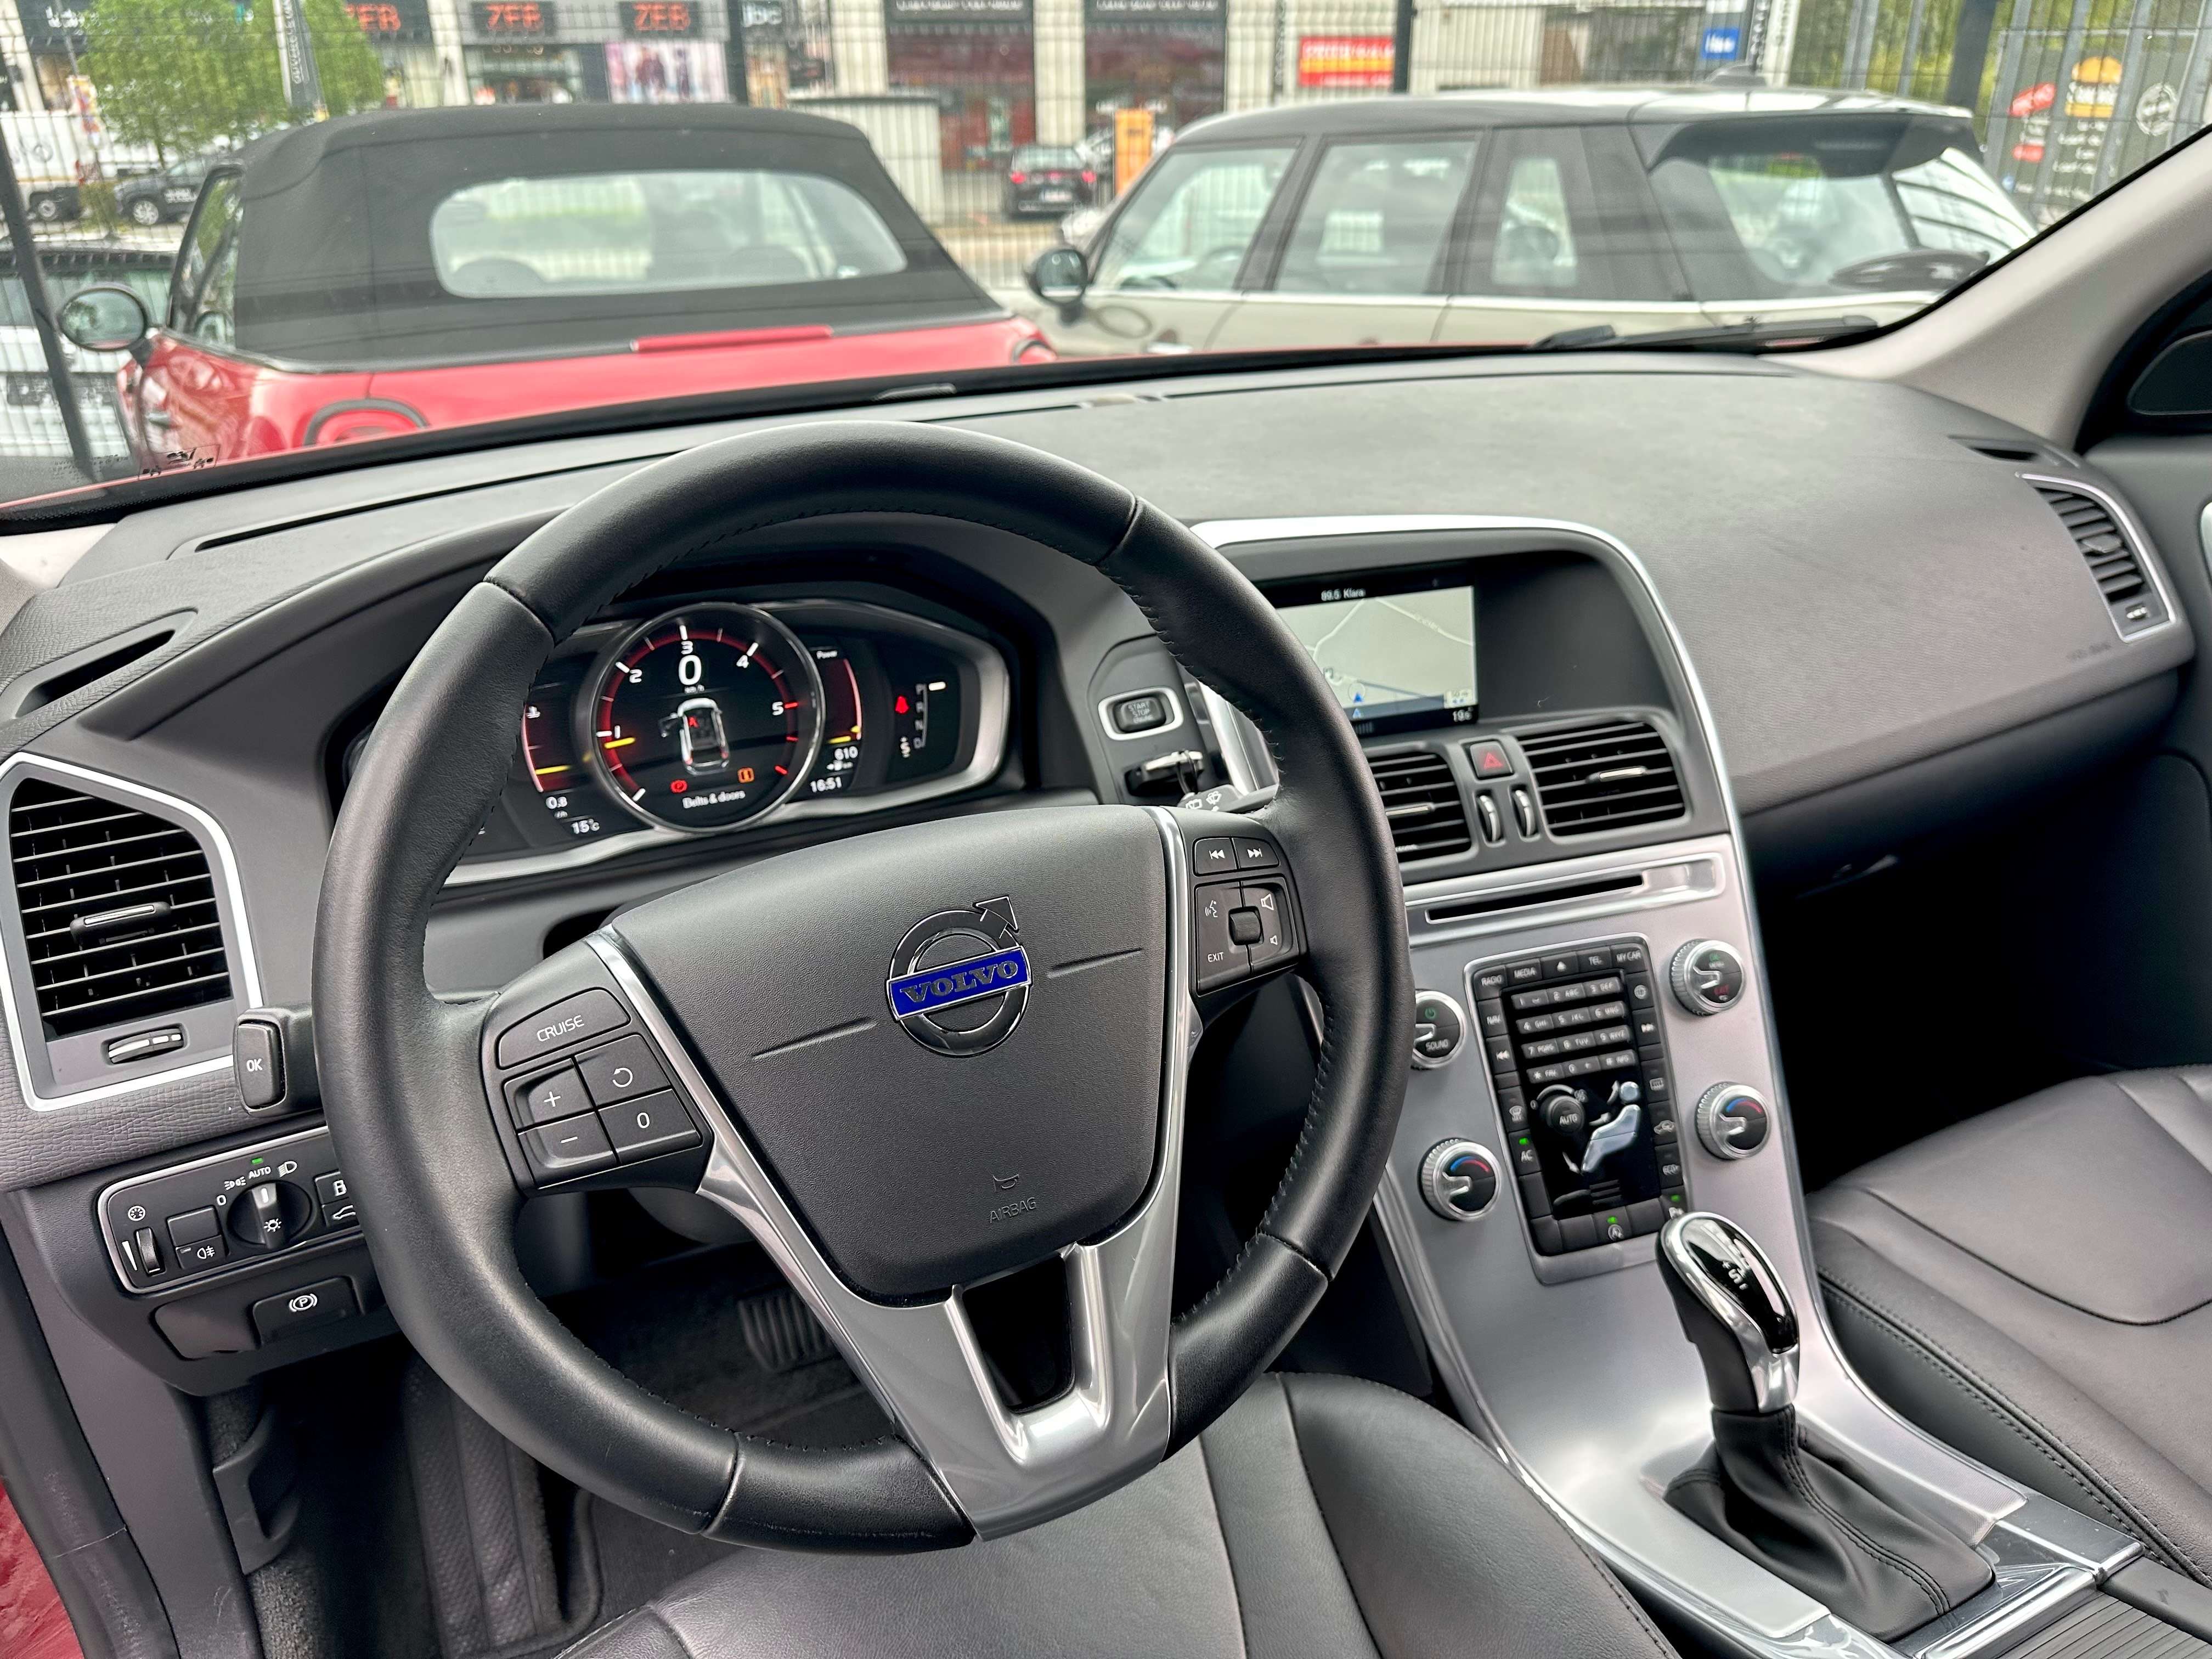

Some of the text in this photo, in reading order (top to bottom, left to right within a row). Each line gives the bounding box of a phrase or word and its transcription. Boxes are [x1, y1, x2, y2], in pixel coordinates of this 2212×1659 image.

[486, 3, 543, 30] ZEB
[633, 2, 691, 30] ZEB
[681, 641, 693, 655] 3
[736, 654, 749, 668] 4
[629, 669, 642, 684] 2
[678, 654, 702, 685] 0
[772, 702, 784, 716] 5
[1128, 701, 1150, 712] START
[614, 725, 621, 739] 1
[834, 746, 858, 760] 610
[810, 777, 842, 792] 16:51
[545, 796, 568, 809] 0.8
[718, 790, 746, 803] doors
[1207, 952, 1224, 962] EXIT
[1481, 974, 1502, 986] RADIO
[1514, 967, 1536, 979] MEDIA
[899, 960, 1018, 1003] VOLVO
[537, 1014, 585, 1042] CRUISE
[1425, 1038, 1449, 1052] SOUND
[246, 1058, 263, 1072] OK
[636, 1111, 651, 1128] 0
[1559, 1113, 1578, 1126] AUTO
[1521, 1150, 1532, 1163] AC
[248, 1166, 272, 1180] AUTO
[989, 1197, 1036, 1224] AIRBAG
